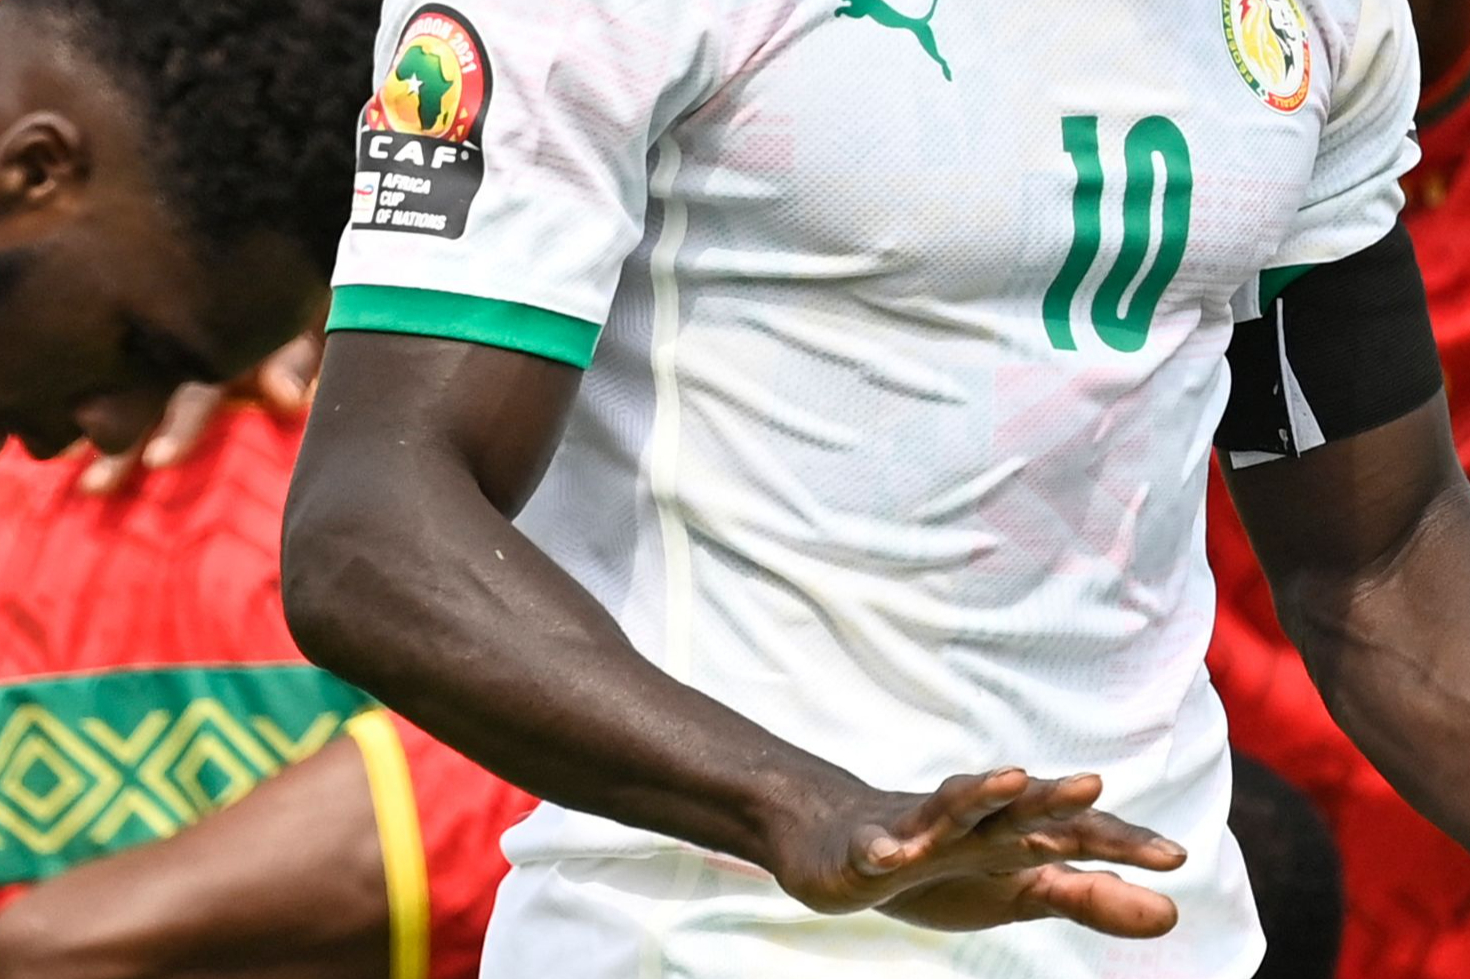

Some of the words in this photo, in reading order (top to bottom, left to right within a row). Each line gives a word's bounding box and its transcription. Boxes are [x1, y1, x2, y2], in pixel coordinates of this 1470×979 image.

[448, 32, 478, 74] 2021
[368, 135, 458, 169] CAF
[382, 172, 431, 195] AFRICA
[379, 190, 405, 207] CUP
[375, 208, 392, 224] OF
[391, 209, 447, 231] NATIONS
[1042, 115, 1193, 353] 10
